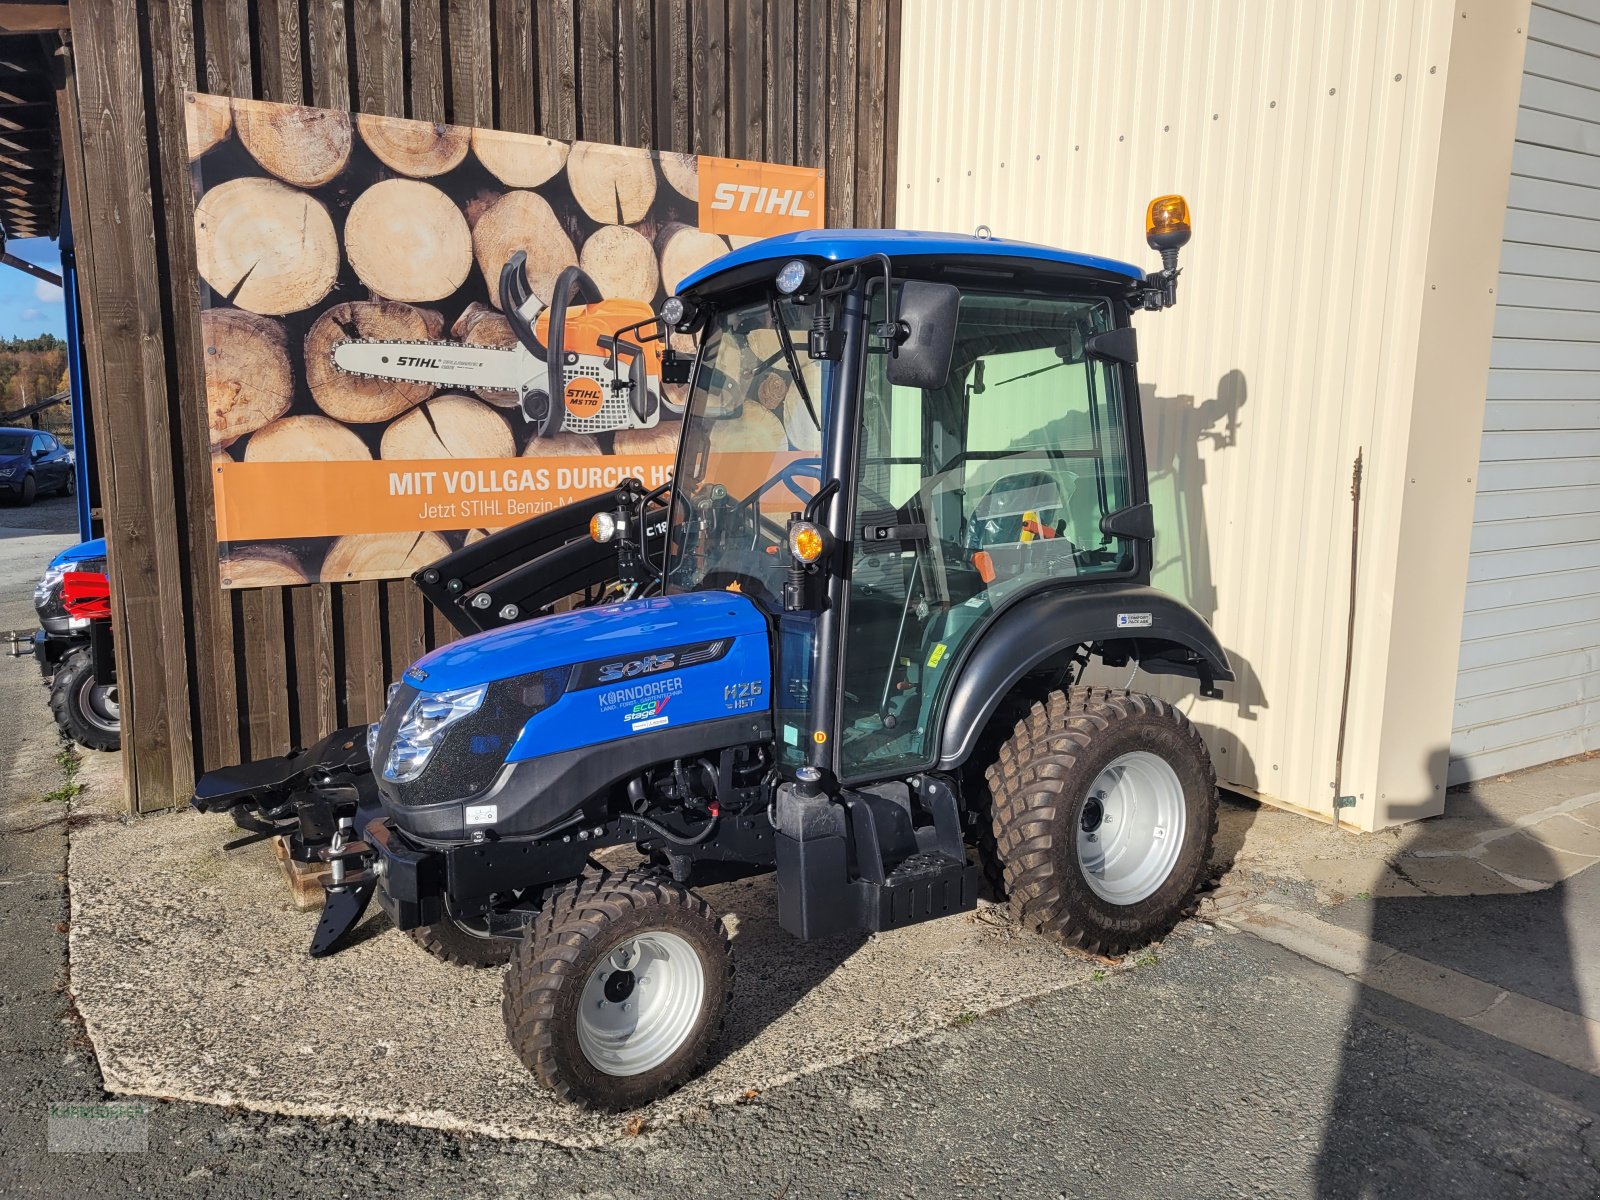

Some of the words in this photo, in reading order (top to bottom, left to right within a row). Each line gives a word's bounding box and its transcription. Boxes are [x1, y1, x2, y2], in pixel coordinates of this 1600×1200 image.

[711, 183, 811, 218] STIHL
[397, 356, 440, 369] STIHL
[566, 389, 600, 399] STIHL
[570, 398, 583, 406] MS
[389, 472, 437, 496] MIT
[442, 468, 551, 494] VOLLGAS
[557, 465, 645, 490] DURCHS
[419, 502, 457, 519] Jetzt
[461, 499, 503, 517] STIHL
[734, 698, 756, 710] HST
[816, 732, 824, 741] D
